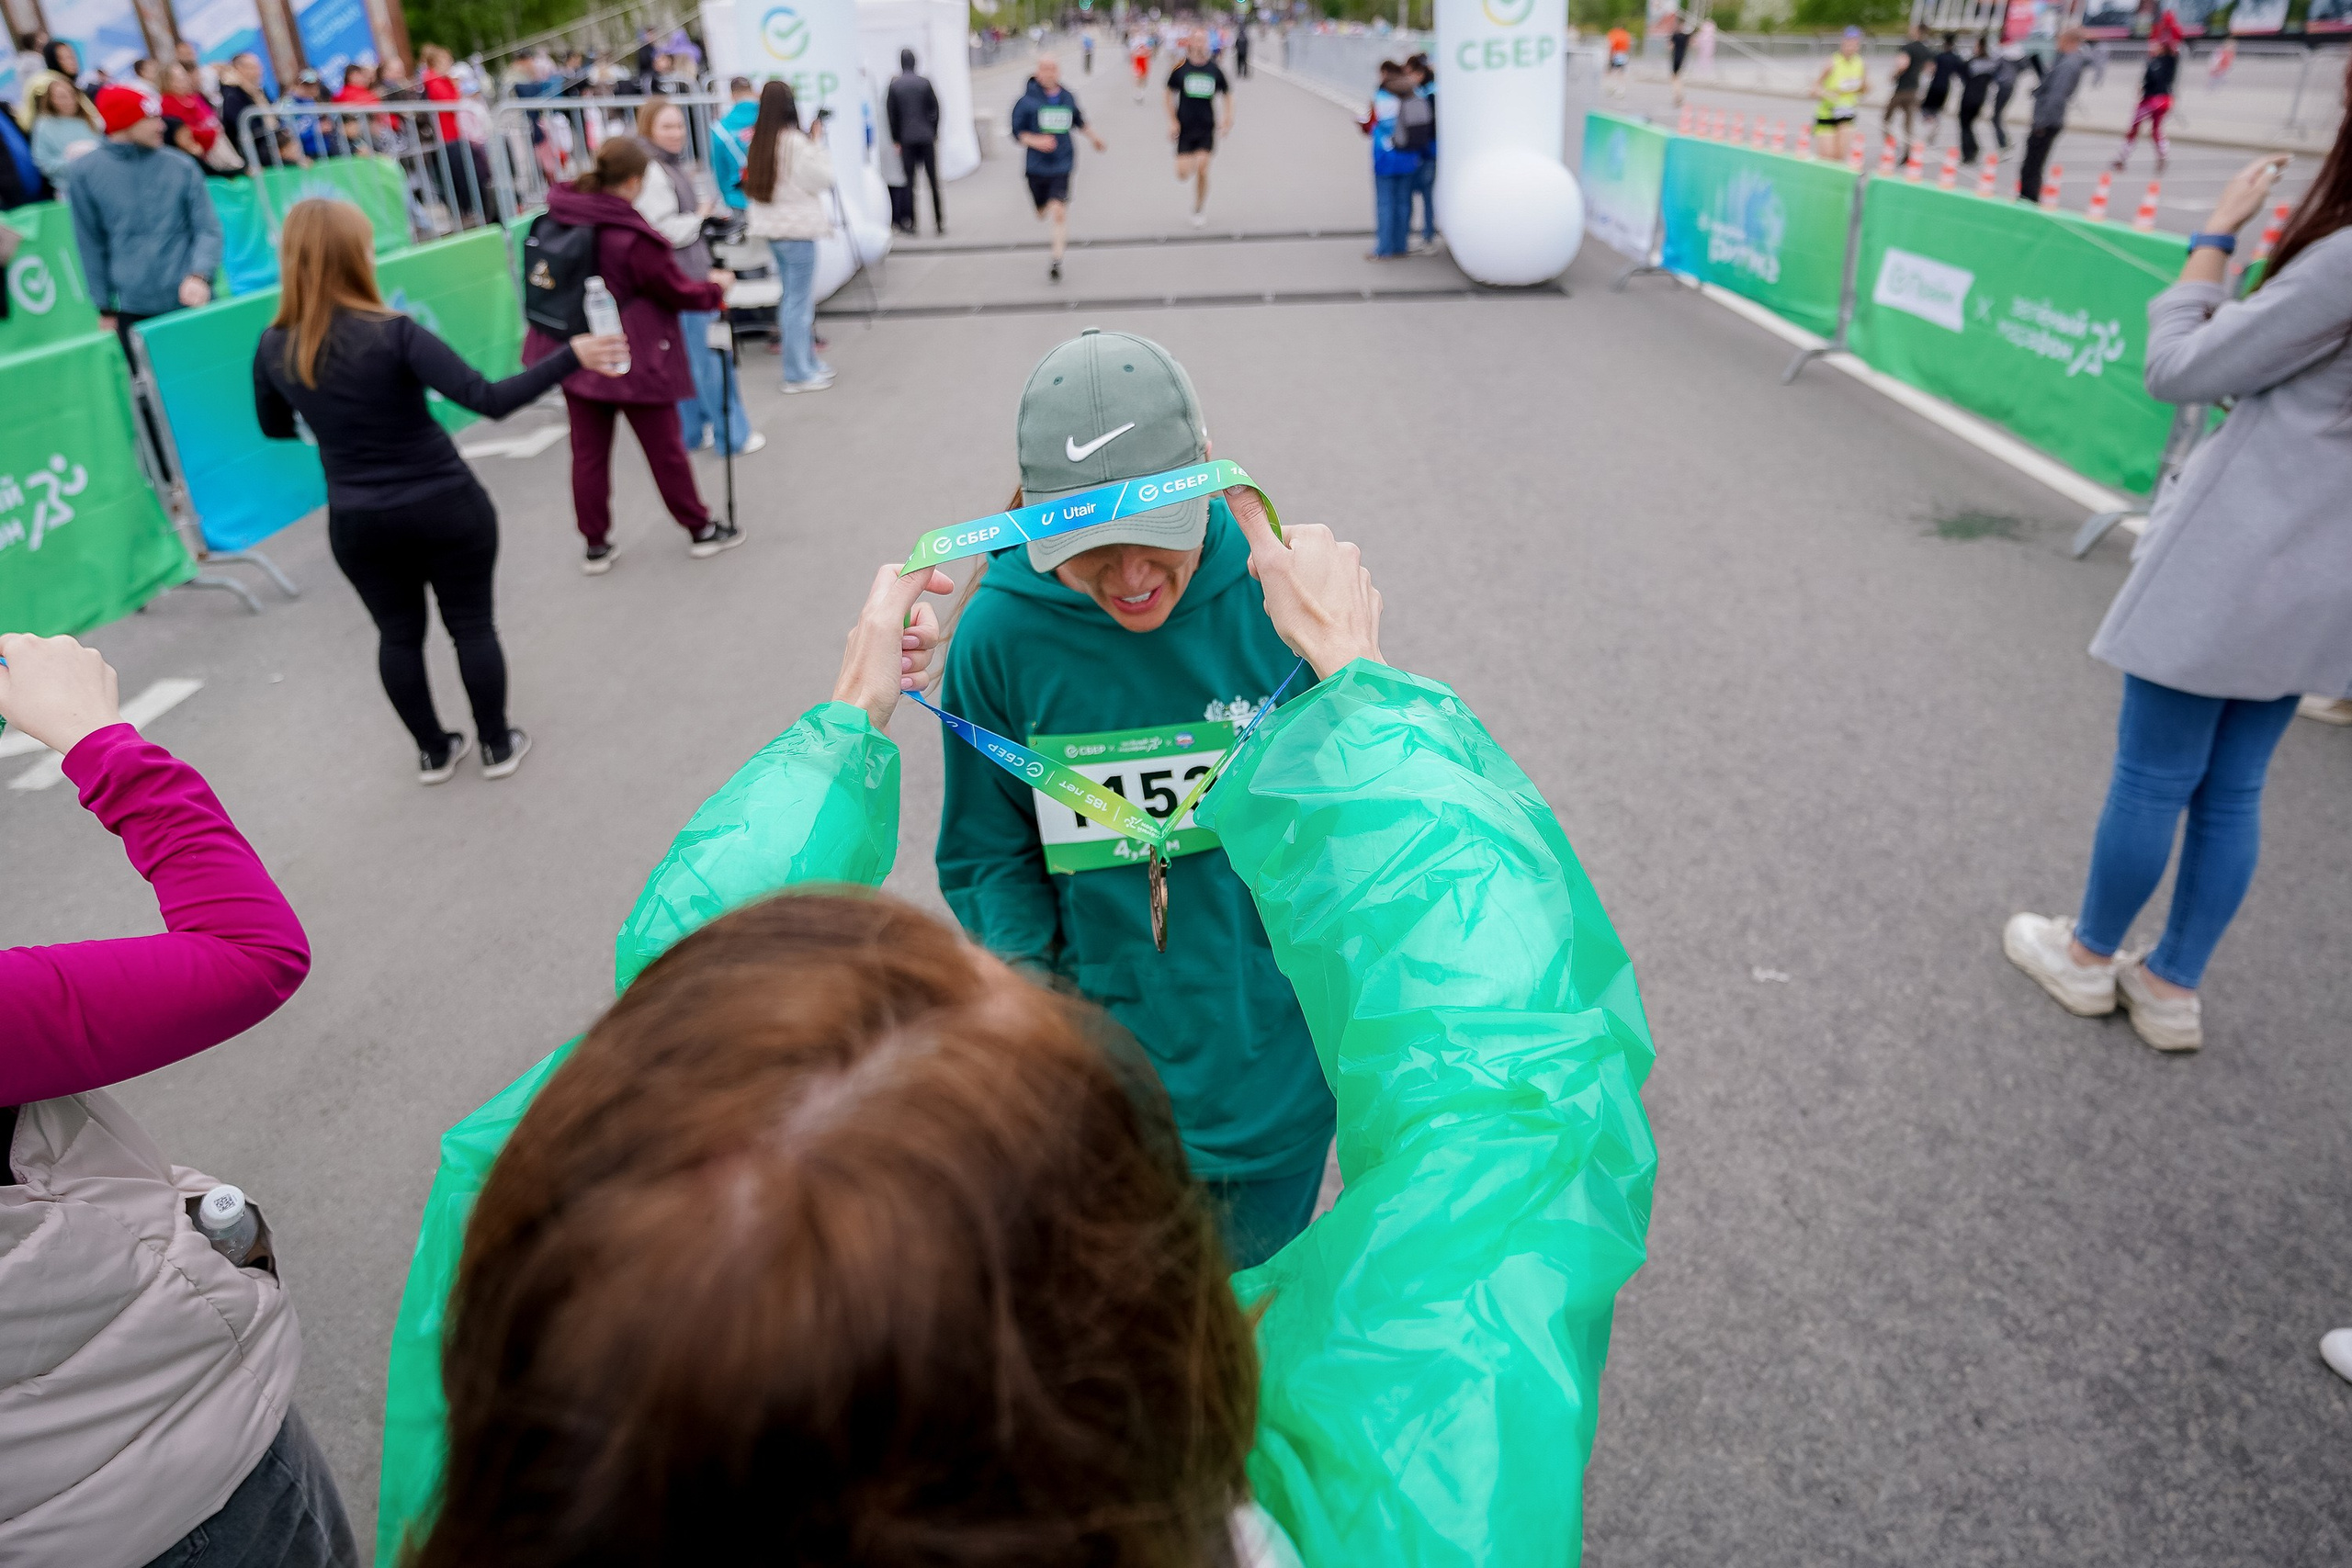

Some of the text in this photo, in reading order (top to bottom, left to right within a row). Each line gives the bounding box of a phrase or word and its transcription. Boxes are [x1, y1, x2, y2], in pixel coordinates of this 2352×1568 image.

[1455, 35, 1555, 72] СБЕР
[1163, 473, 1209, 493] СБЕР
[1063, 502, 1097, 520] Utair
[956, 526, 1001, 547] СБЕР
[988, 743, 1025, 767] СБЕР
[1058, 781, 1108, 812] 185 лет
